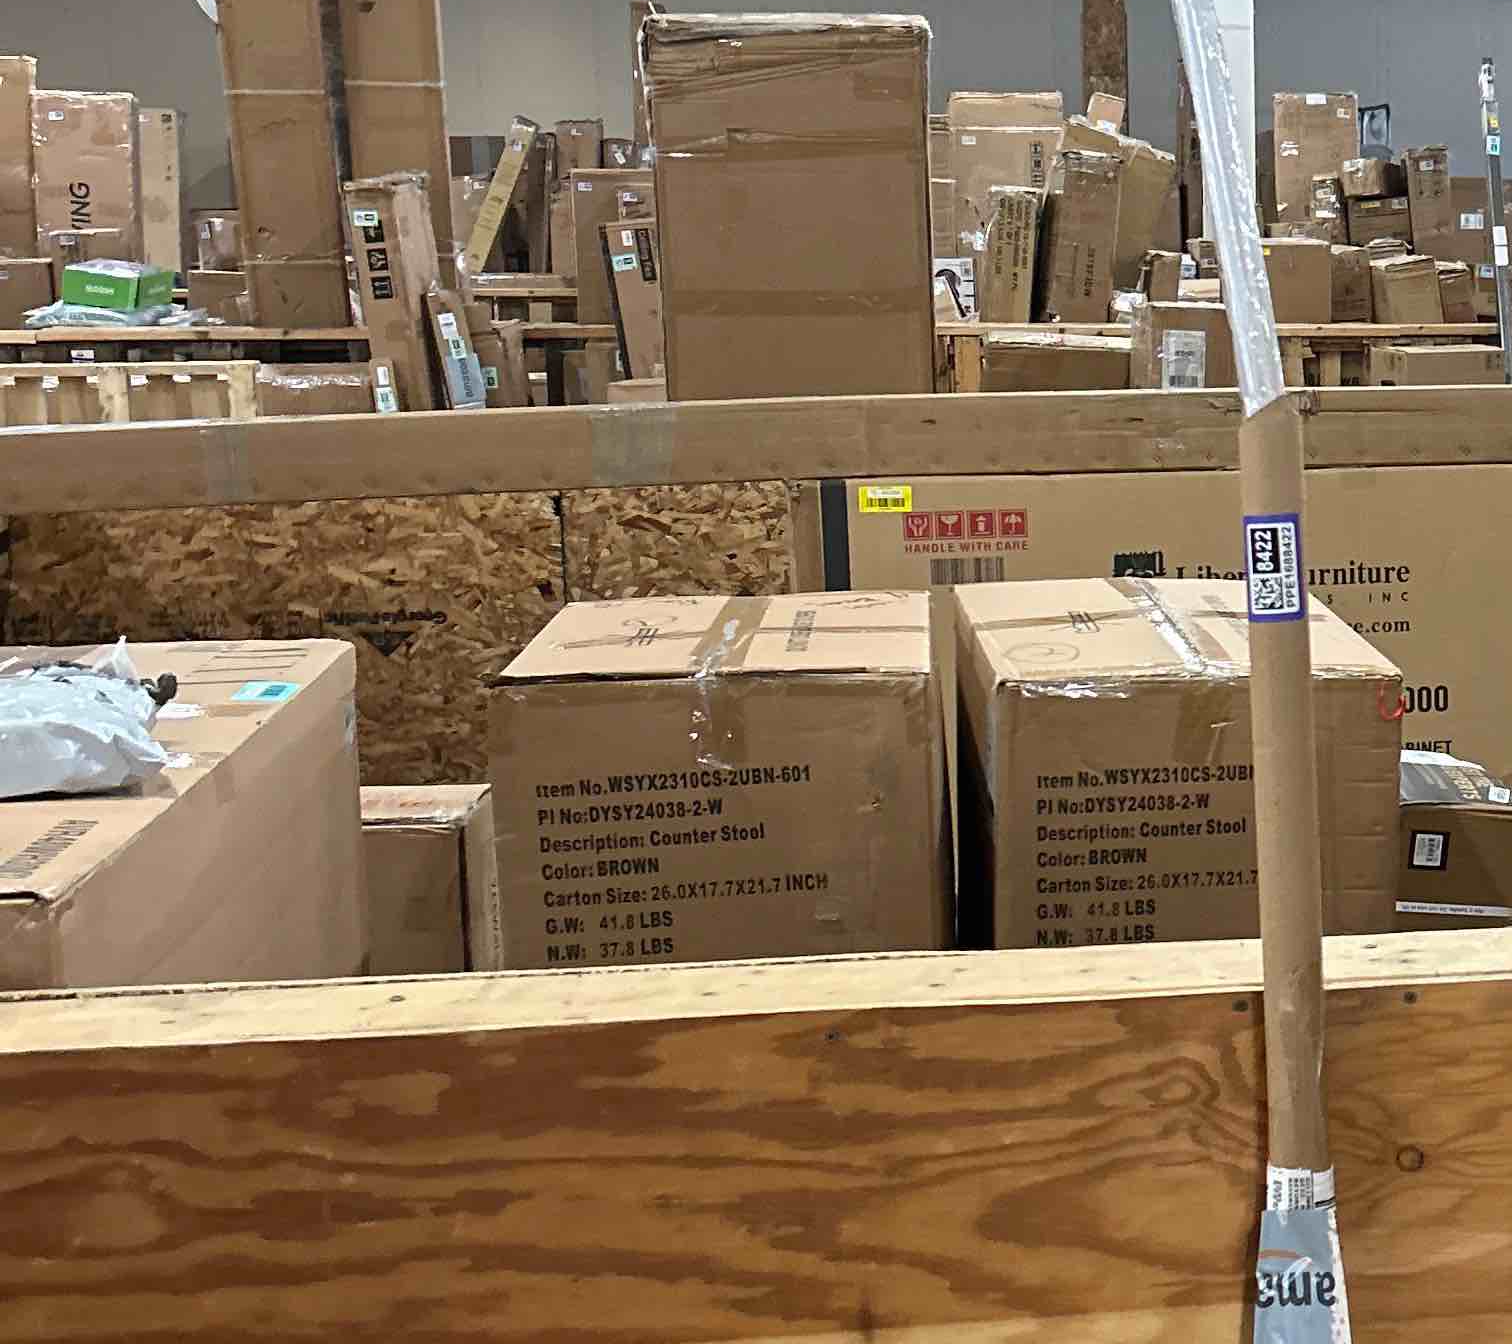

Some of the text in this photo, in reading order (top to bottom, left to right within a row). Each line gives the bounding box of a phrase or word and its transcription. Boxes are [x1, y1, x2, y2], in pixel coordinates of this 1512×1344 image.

[904, 540, 1030, 553] HANDLE WITH CARE
[1254, 528, 1274, 573] 8422
[1281, 525, 1296, 609] PPE1688422
[1308, 561, 1411, 586] urniture
[1368, 590, 1410, 604] INC
[536, 782, 576, 798] Item
[1037, 773, 1074, 789] Item
[539, 822, 766, 854] Description: Counter Stool
[1036, 817, 1247, 844] Description: Counter Stool
[1036, 848, 1148, 868] Color: BROWN
[541, 857, 660, 881] Color: BROWN
[543, 873, 829, 907] Carton Size: 26.0X17.7X21.7 INCH
[1036, 878, 1091, 895] Carton
[1095, 875, 1134, 892] Size:
[1087, 900, 1121, 919] 41.8
[1124, 899, 1156, 917] LBS
[599, 913, 635, 931] 41.8
[639, 910, 674, 929] LBS
[1085, 926, 1119, 944] 37.8
[1123, 924, 1155, 943] LBS
[599, 940, 635, 959] 37.8
[640, 937, 674, 956] LBS
